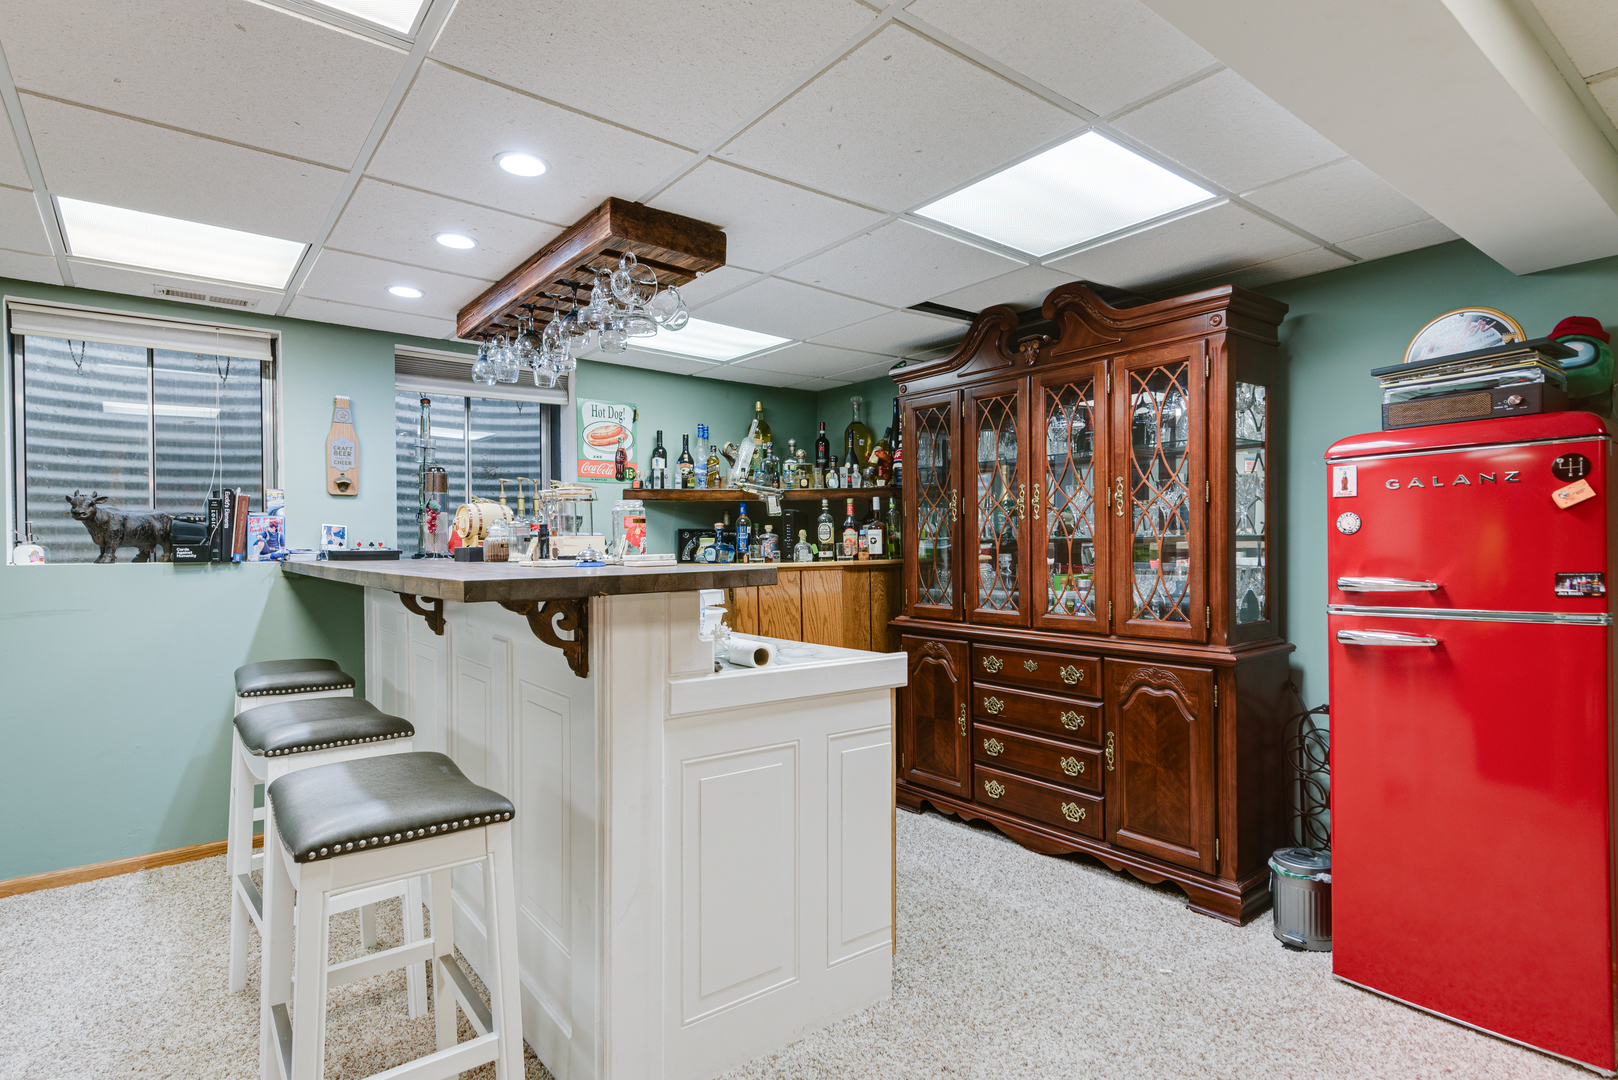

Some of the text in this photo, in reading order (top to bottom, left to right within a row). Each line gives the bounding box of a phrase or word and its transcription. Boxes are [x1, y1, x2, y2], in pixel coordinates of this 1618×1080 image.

[591, 404, 626, 424] Hot Dog!
[1385, 470, 1520, 490] GALANZ
[249, 517, 261, 525] MY
